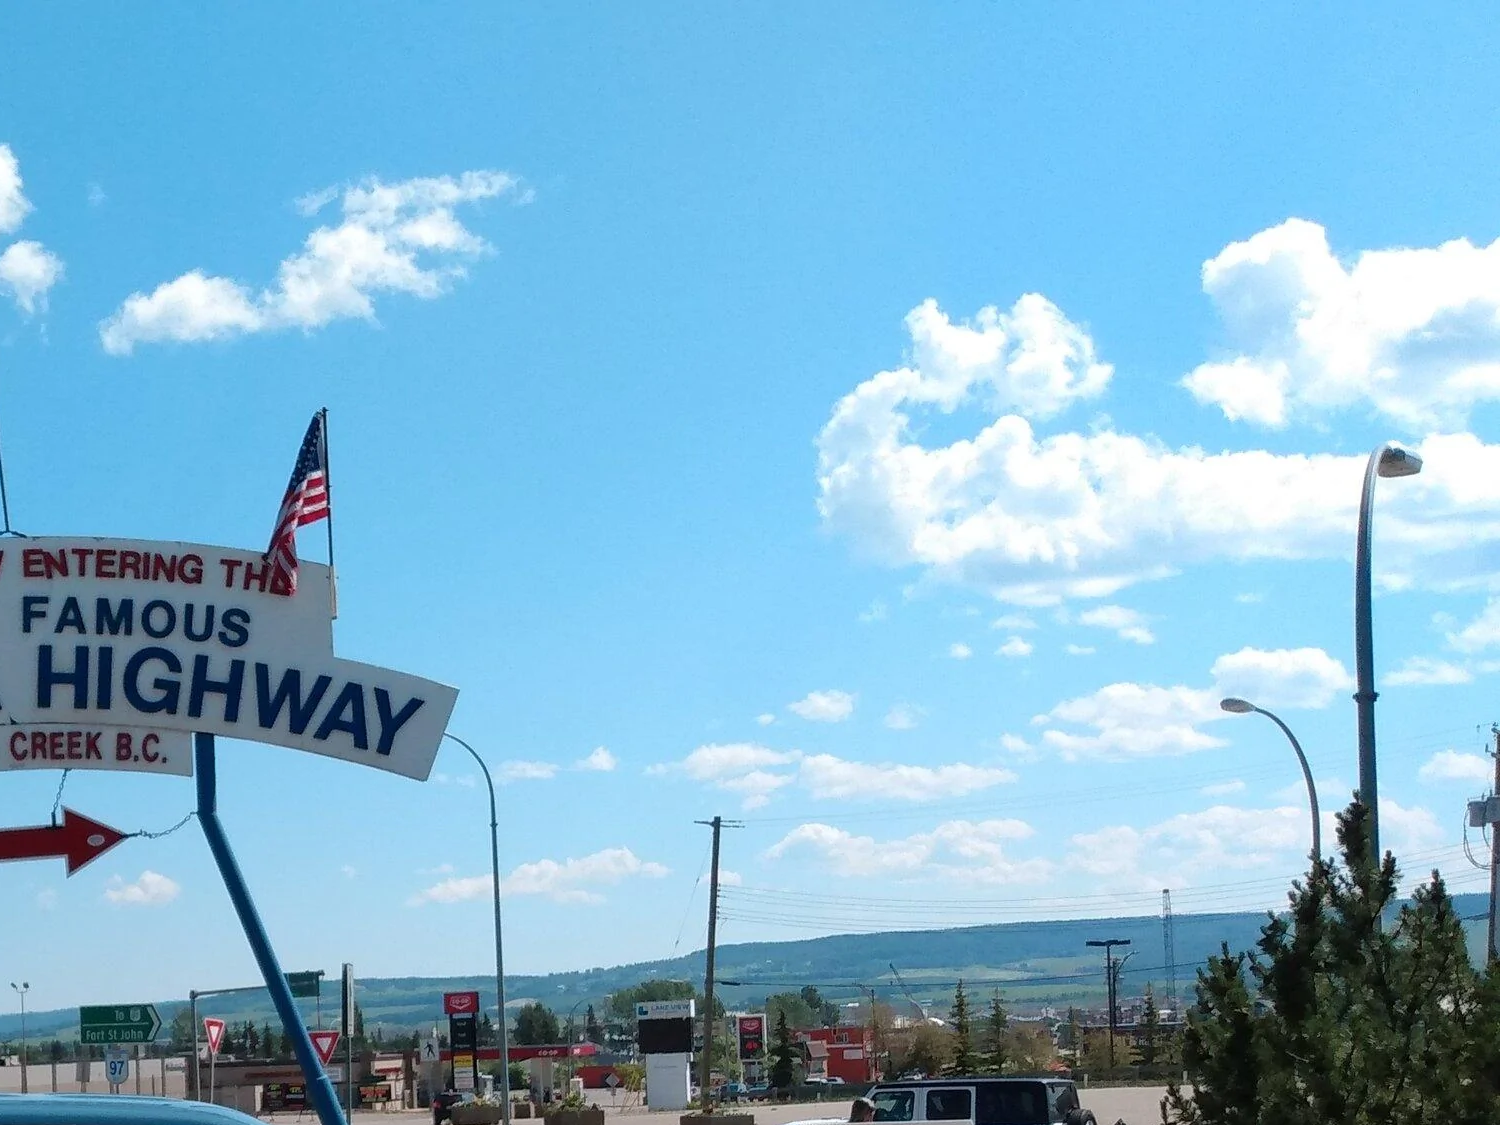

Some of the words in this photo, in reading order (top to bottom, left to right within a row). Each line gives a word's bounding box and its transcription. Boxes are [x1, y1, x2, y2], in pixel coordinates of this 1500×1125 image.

[22, 548, 204, 585] ENTERING
[21, 596, 251, 648] FAMOUS
[36, 644, 426, 757] HIGHWAY
[9, 731, 103, 761] CREEK
[115, 732, 169, 764] B.C.
[114, 1009, 125, 1021] To
[85, 1029, 105, 1041] Fort
[108, 1029, 117, 1041] St
[120, 1028, 144, 1041] John
[109, 1061, 125, 1076] 97
